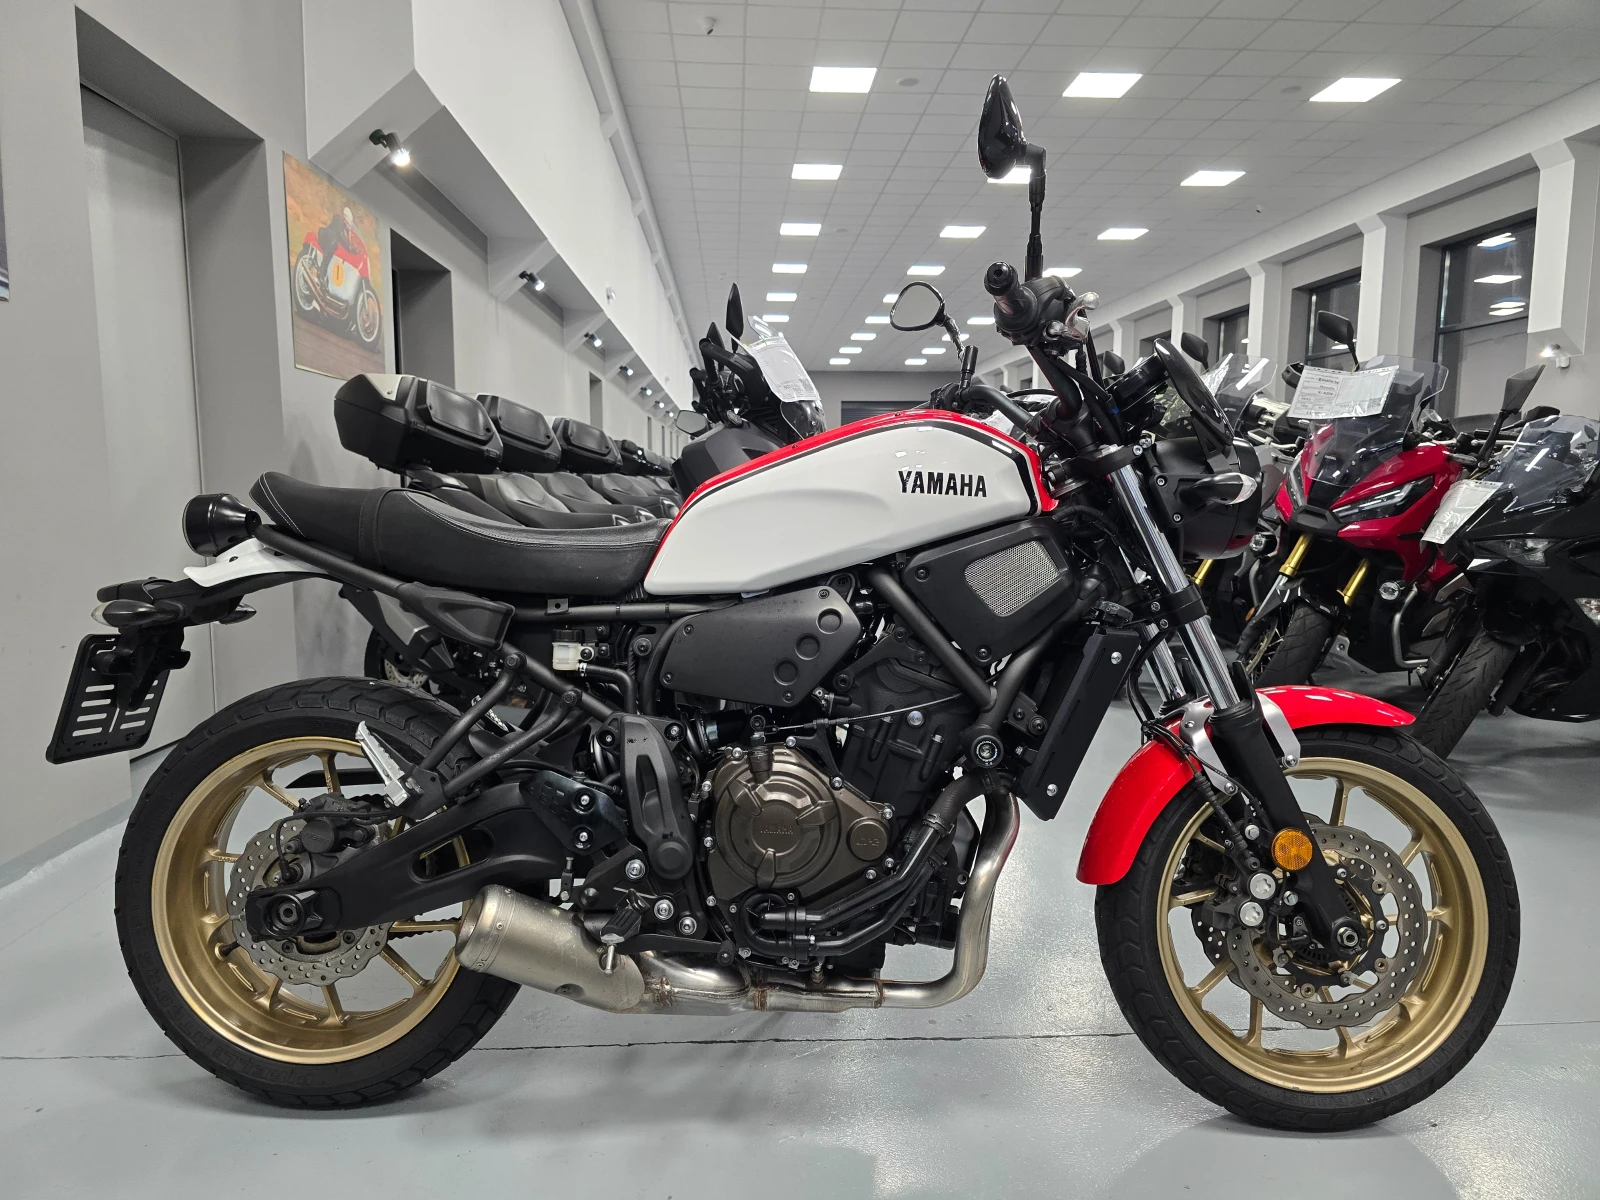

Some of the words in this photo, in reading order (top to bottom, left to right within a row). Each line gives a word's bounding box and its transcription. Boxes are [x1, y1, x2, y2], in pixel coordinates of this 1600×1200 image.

[898, 470, 987, 498] YAMAHA
[760, 825, 793, 835] YAMAHA
[210, 1044, 313, 1087] PIRELLI
